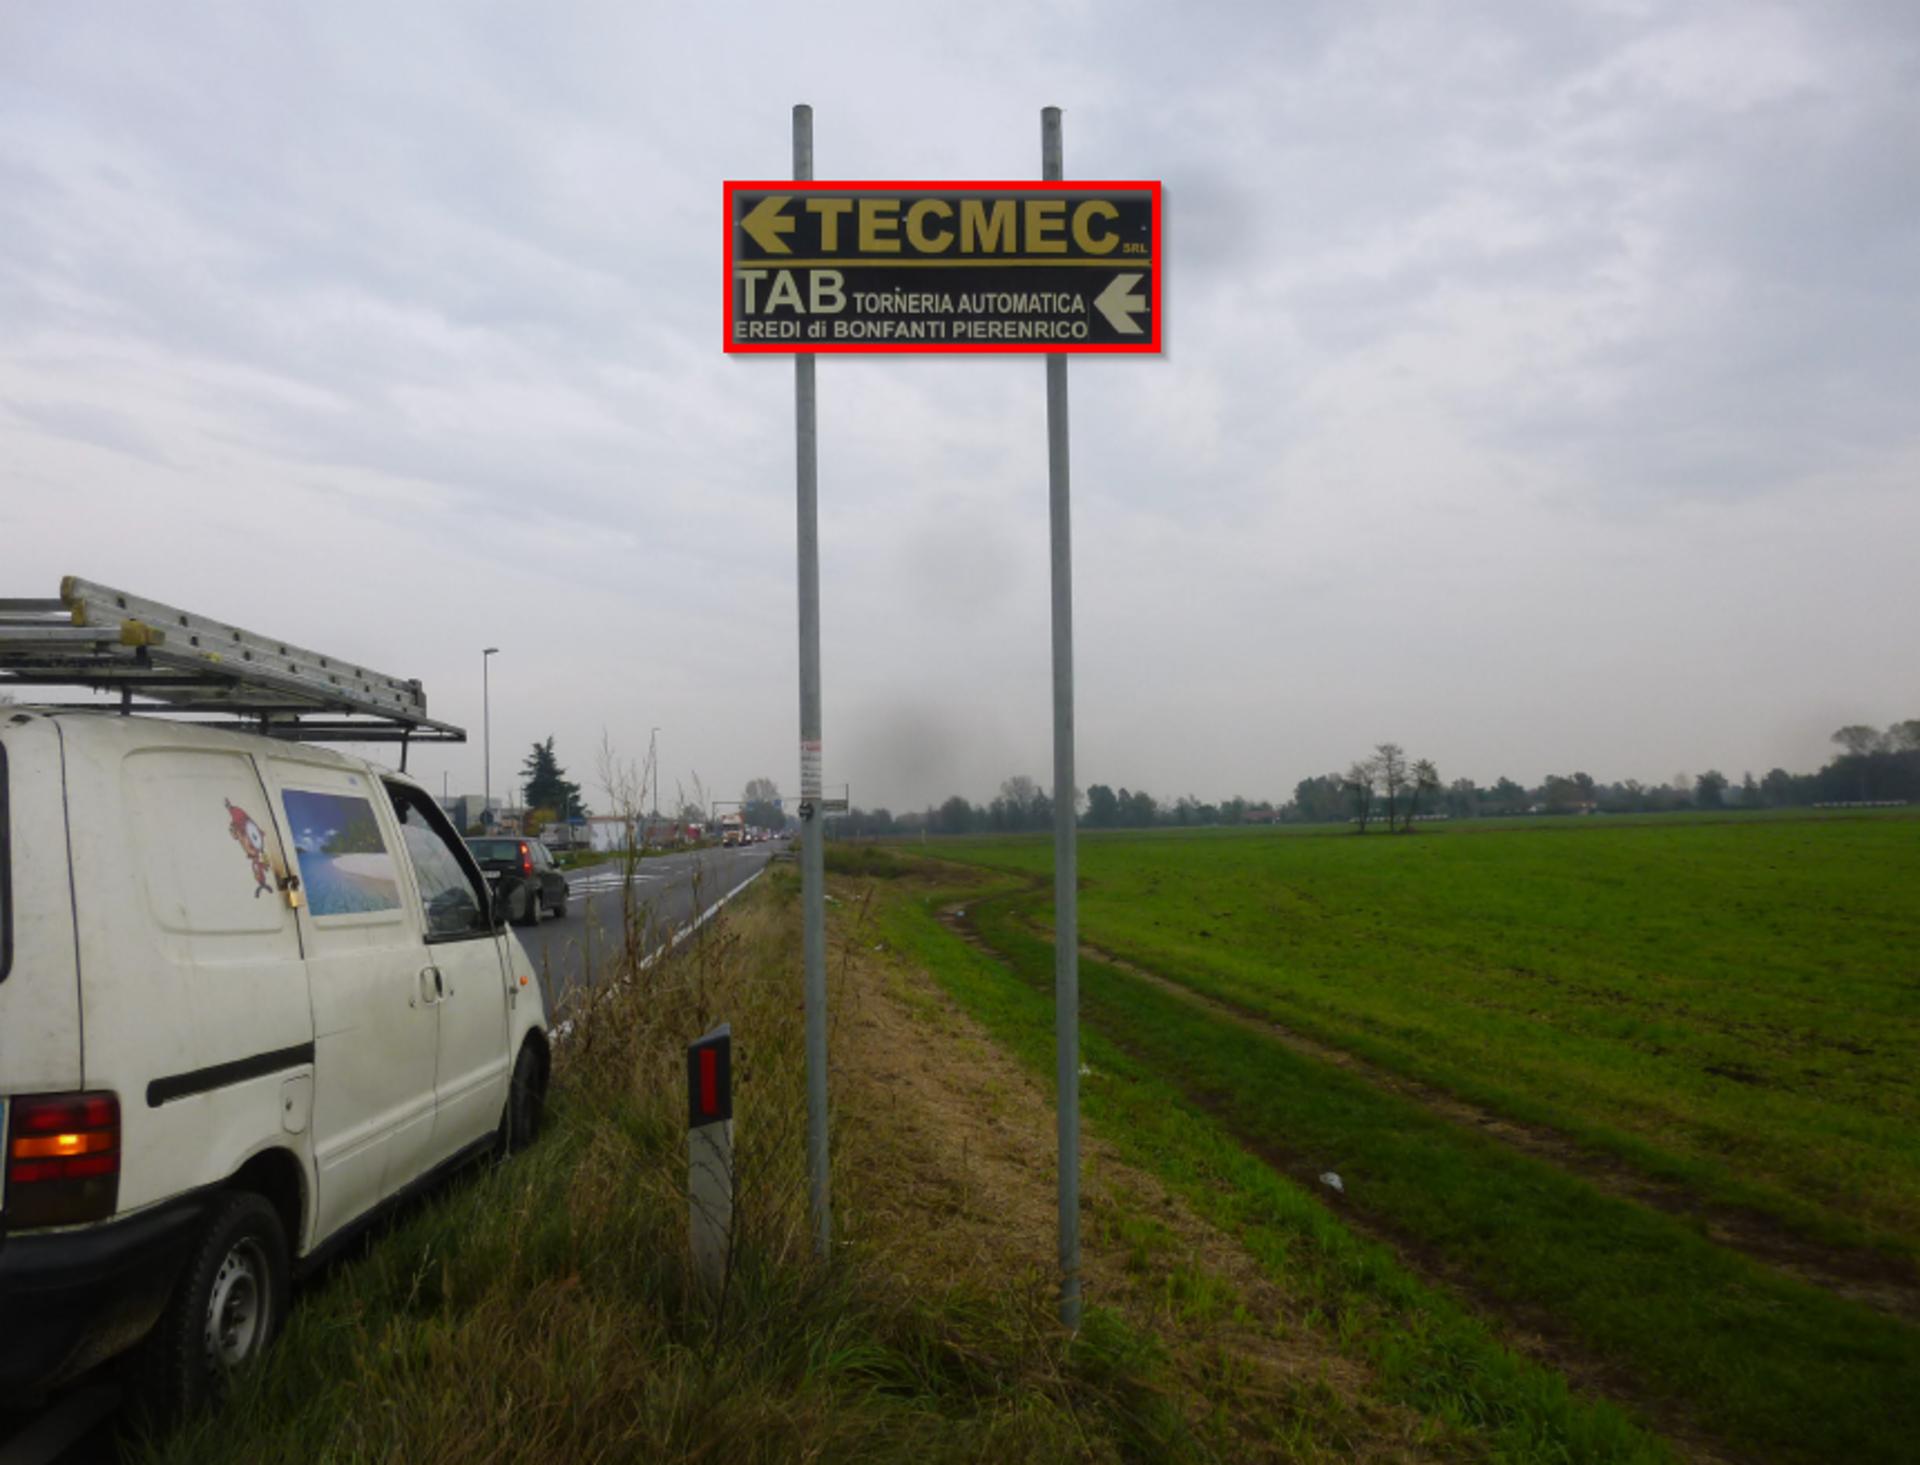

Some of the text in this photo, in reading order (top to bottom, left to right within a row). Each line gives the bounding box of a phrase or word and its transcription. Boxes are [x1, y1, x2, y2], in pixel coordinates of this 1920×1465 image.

[805, 198, 1148, 255] TECMEC SRL
[734, 269, 1086, 314] TAB TORNERIA AUTOMATICA
[734, 319, 1089, 339] EREDI di BONFANTI PIERENRICO
